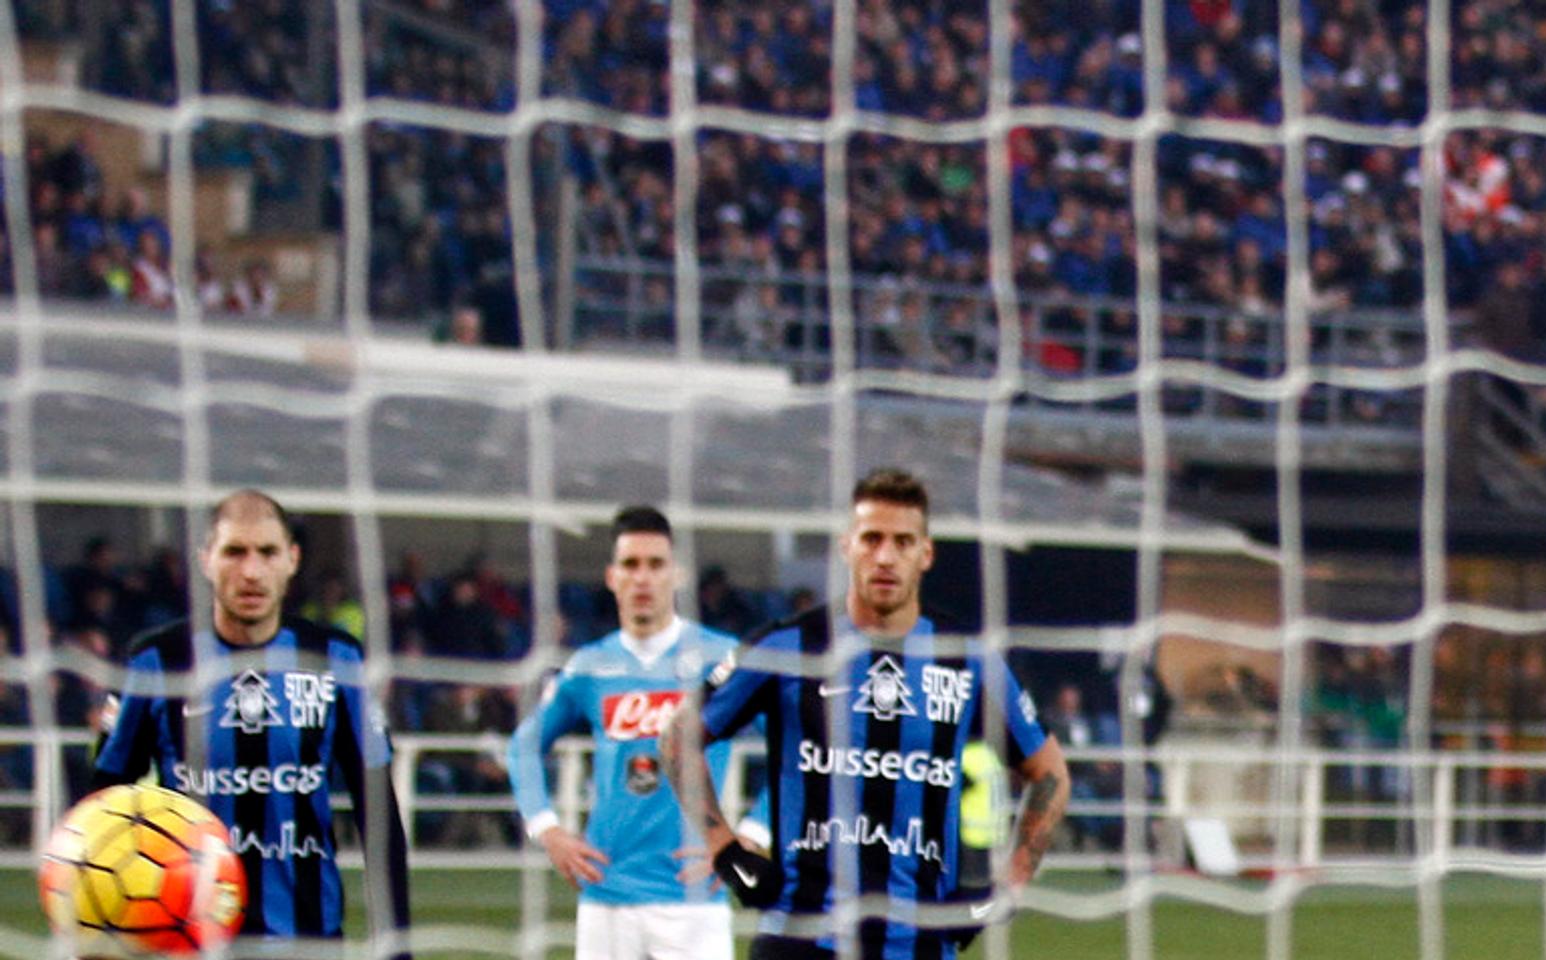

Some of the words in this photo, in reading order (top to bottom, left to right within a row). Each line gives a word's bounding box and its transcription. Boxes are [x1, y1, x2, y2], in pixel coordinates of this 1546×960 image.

[283, 673, 336, 702] STONE
[922, 665, 974, 699] STONE
[290, 701, 328, 729] CITY
[926, 694, 964, 724] CITY
